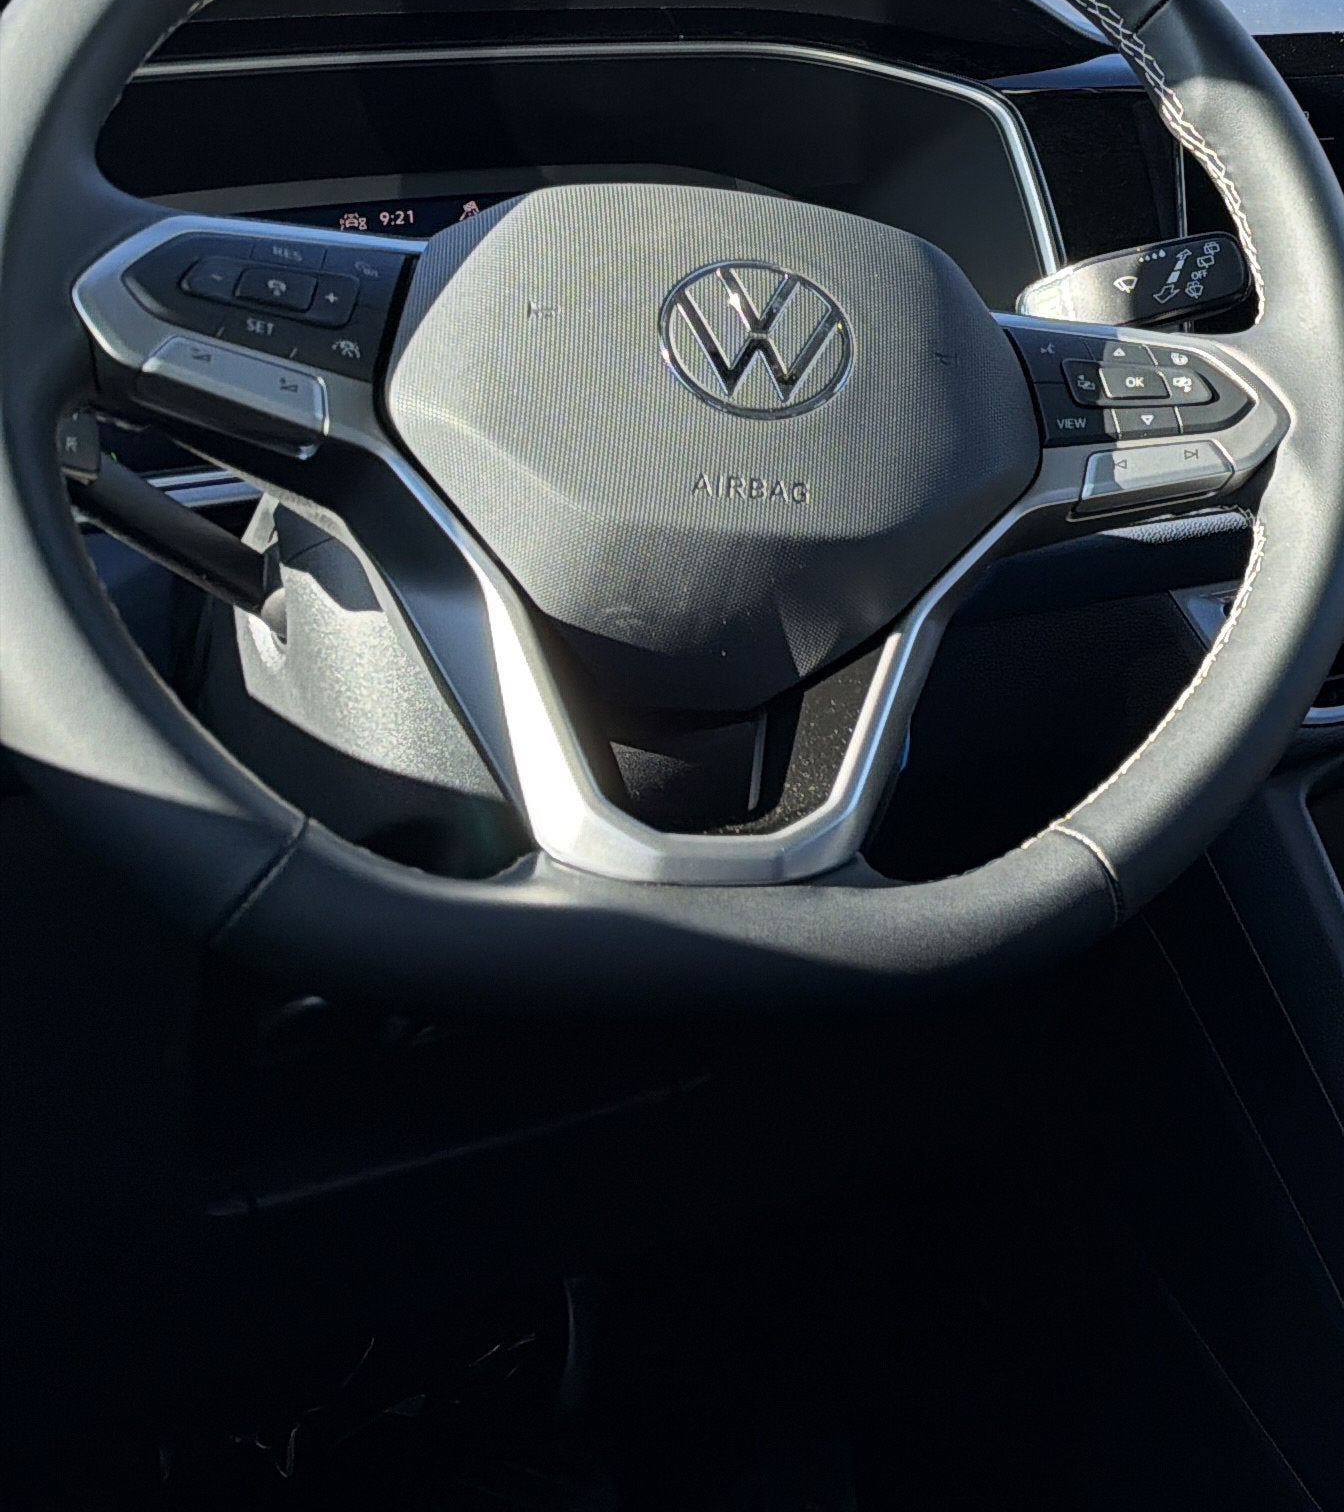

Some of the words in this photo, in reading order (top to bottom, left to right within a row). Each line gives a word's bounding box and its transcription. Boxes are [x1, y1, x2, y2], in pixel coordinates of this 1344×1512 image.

[379, 210, 415, 226] 9:21
[272, 245, 303, 262] RES
[1190, 269, 1209, 280] OFF
[246, 318, 275, 336] SET
[1125, 376, 1145, 388] OK
[1056, 417, 1087, 429] VIEW
[691, 471, 811, 505] AIRBAG
